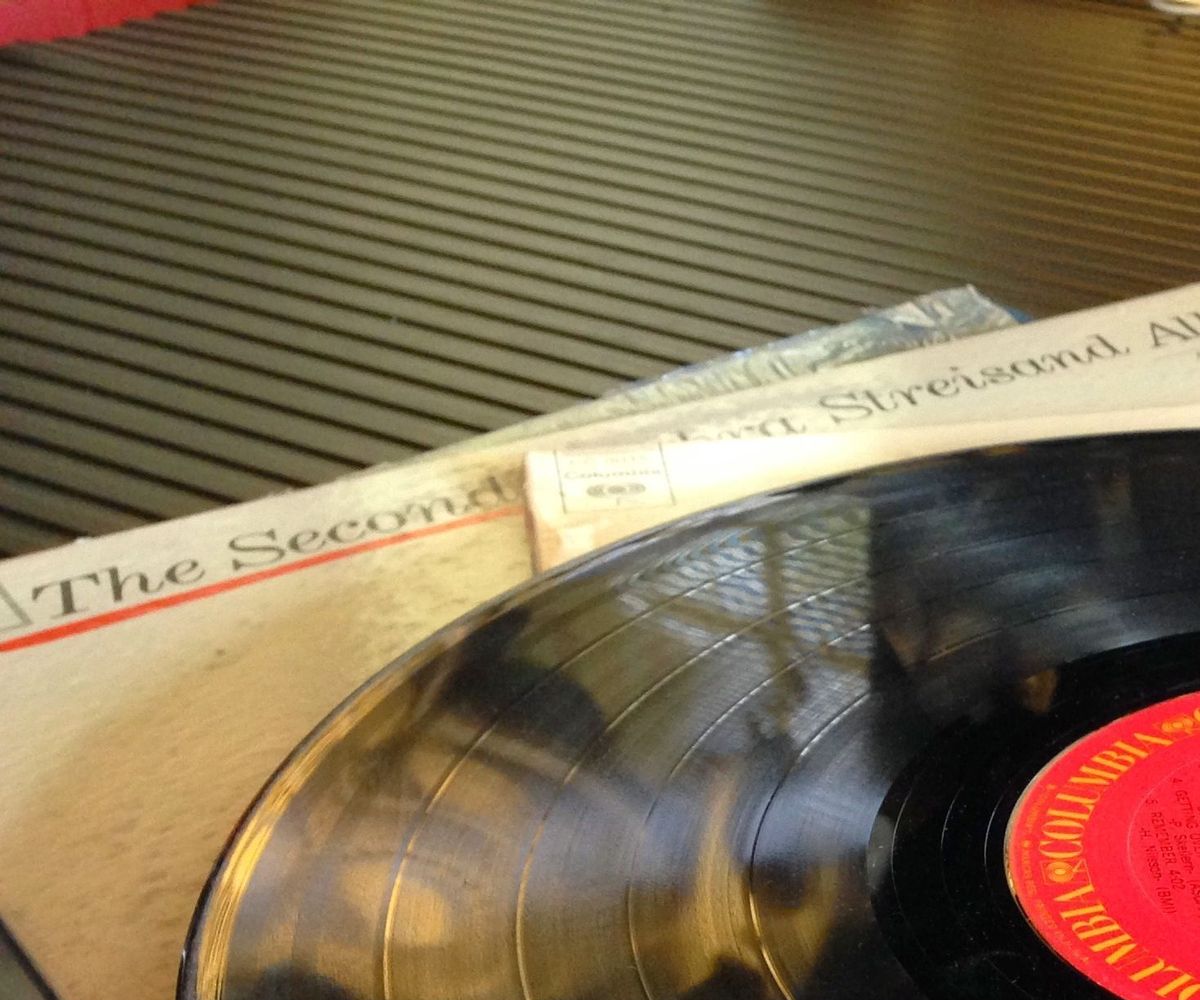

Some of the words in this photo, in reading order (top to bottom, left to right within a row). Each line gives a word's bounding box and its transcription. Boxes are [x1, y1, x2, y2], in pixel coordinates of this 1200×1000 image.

[32, 554, 206, 620] The
[227, 472, 524, 573] Second
[1038, 733, 1174, 860] COLUMBIA
